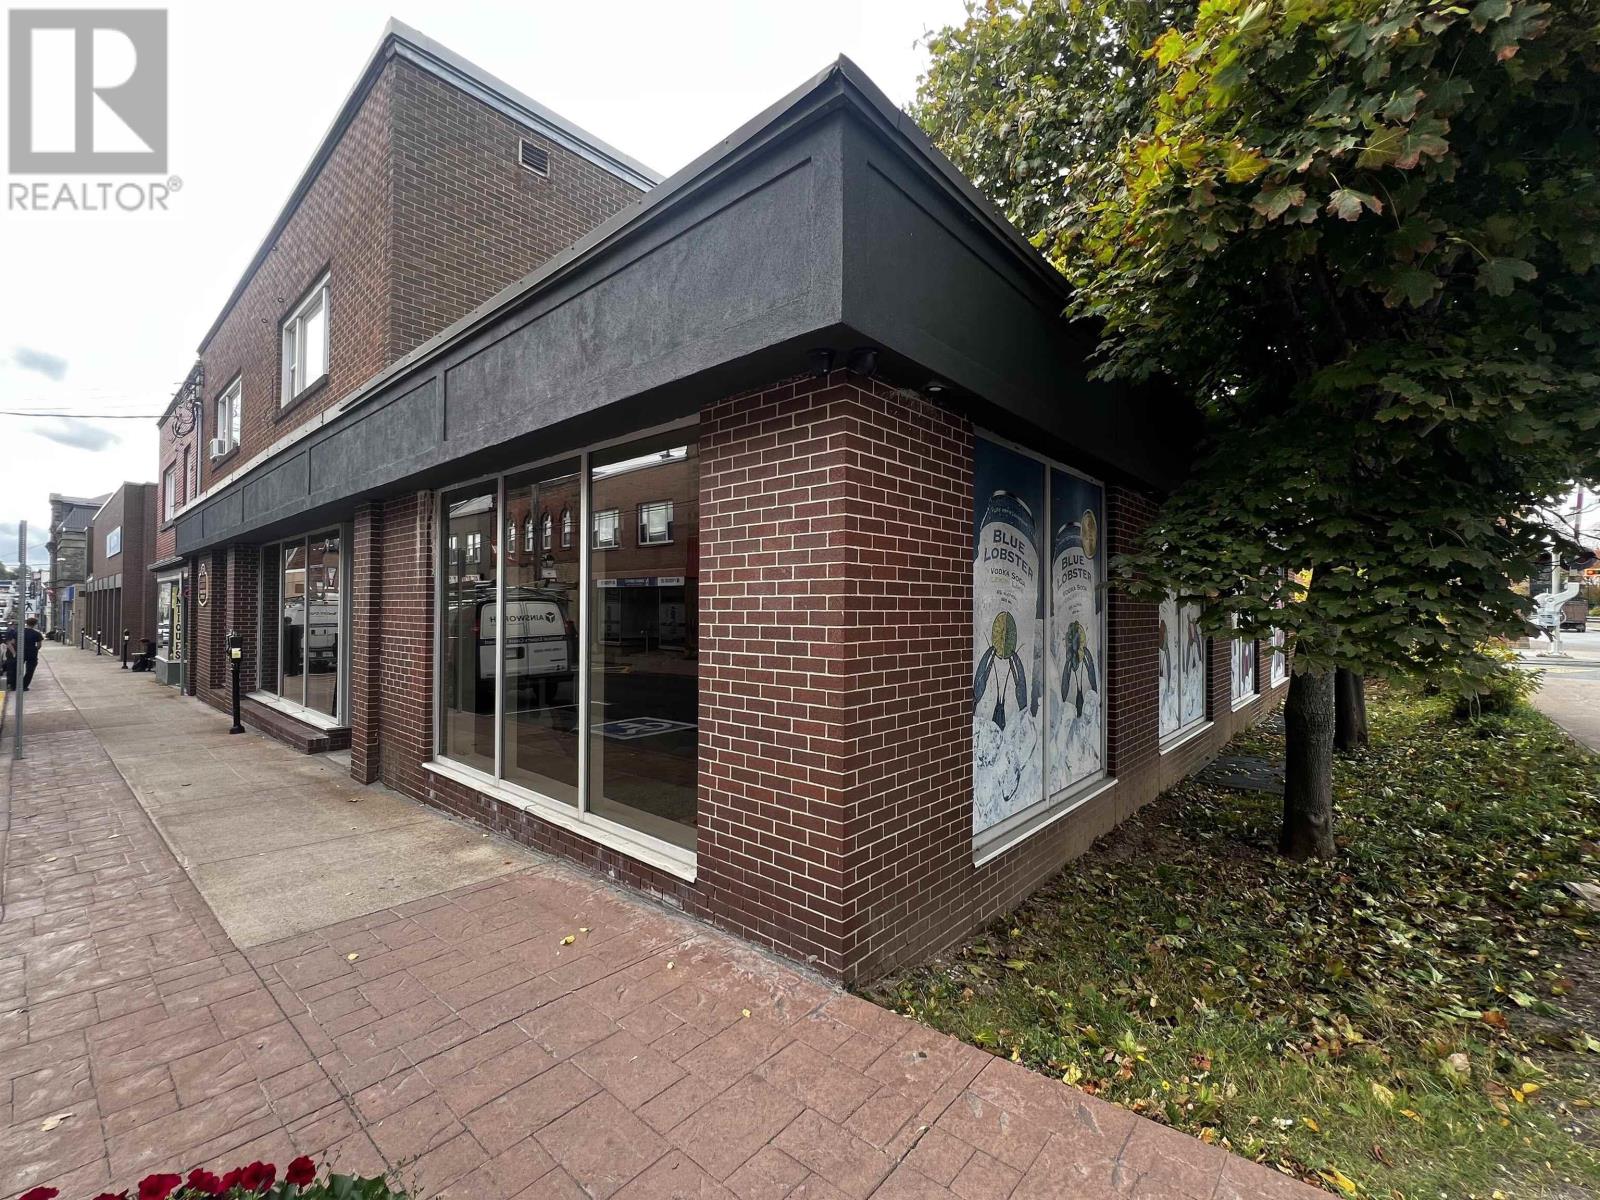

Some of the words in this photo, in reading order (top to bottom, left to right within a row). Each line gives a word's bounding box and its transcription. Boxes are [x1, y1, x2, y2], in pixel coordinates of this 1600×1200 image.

[993, 530, 1025, 555] BLUE
[984, 547, 1034, 581] LOBSTER
[1061, 555, 1084, 569] BLUE
[1057, 568, 1092, 590] LOBSTER
